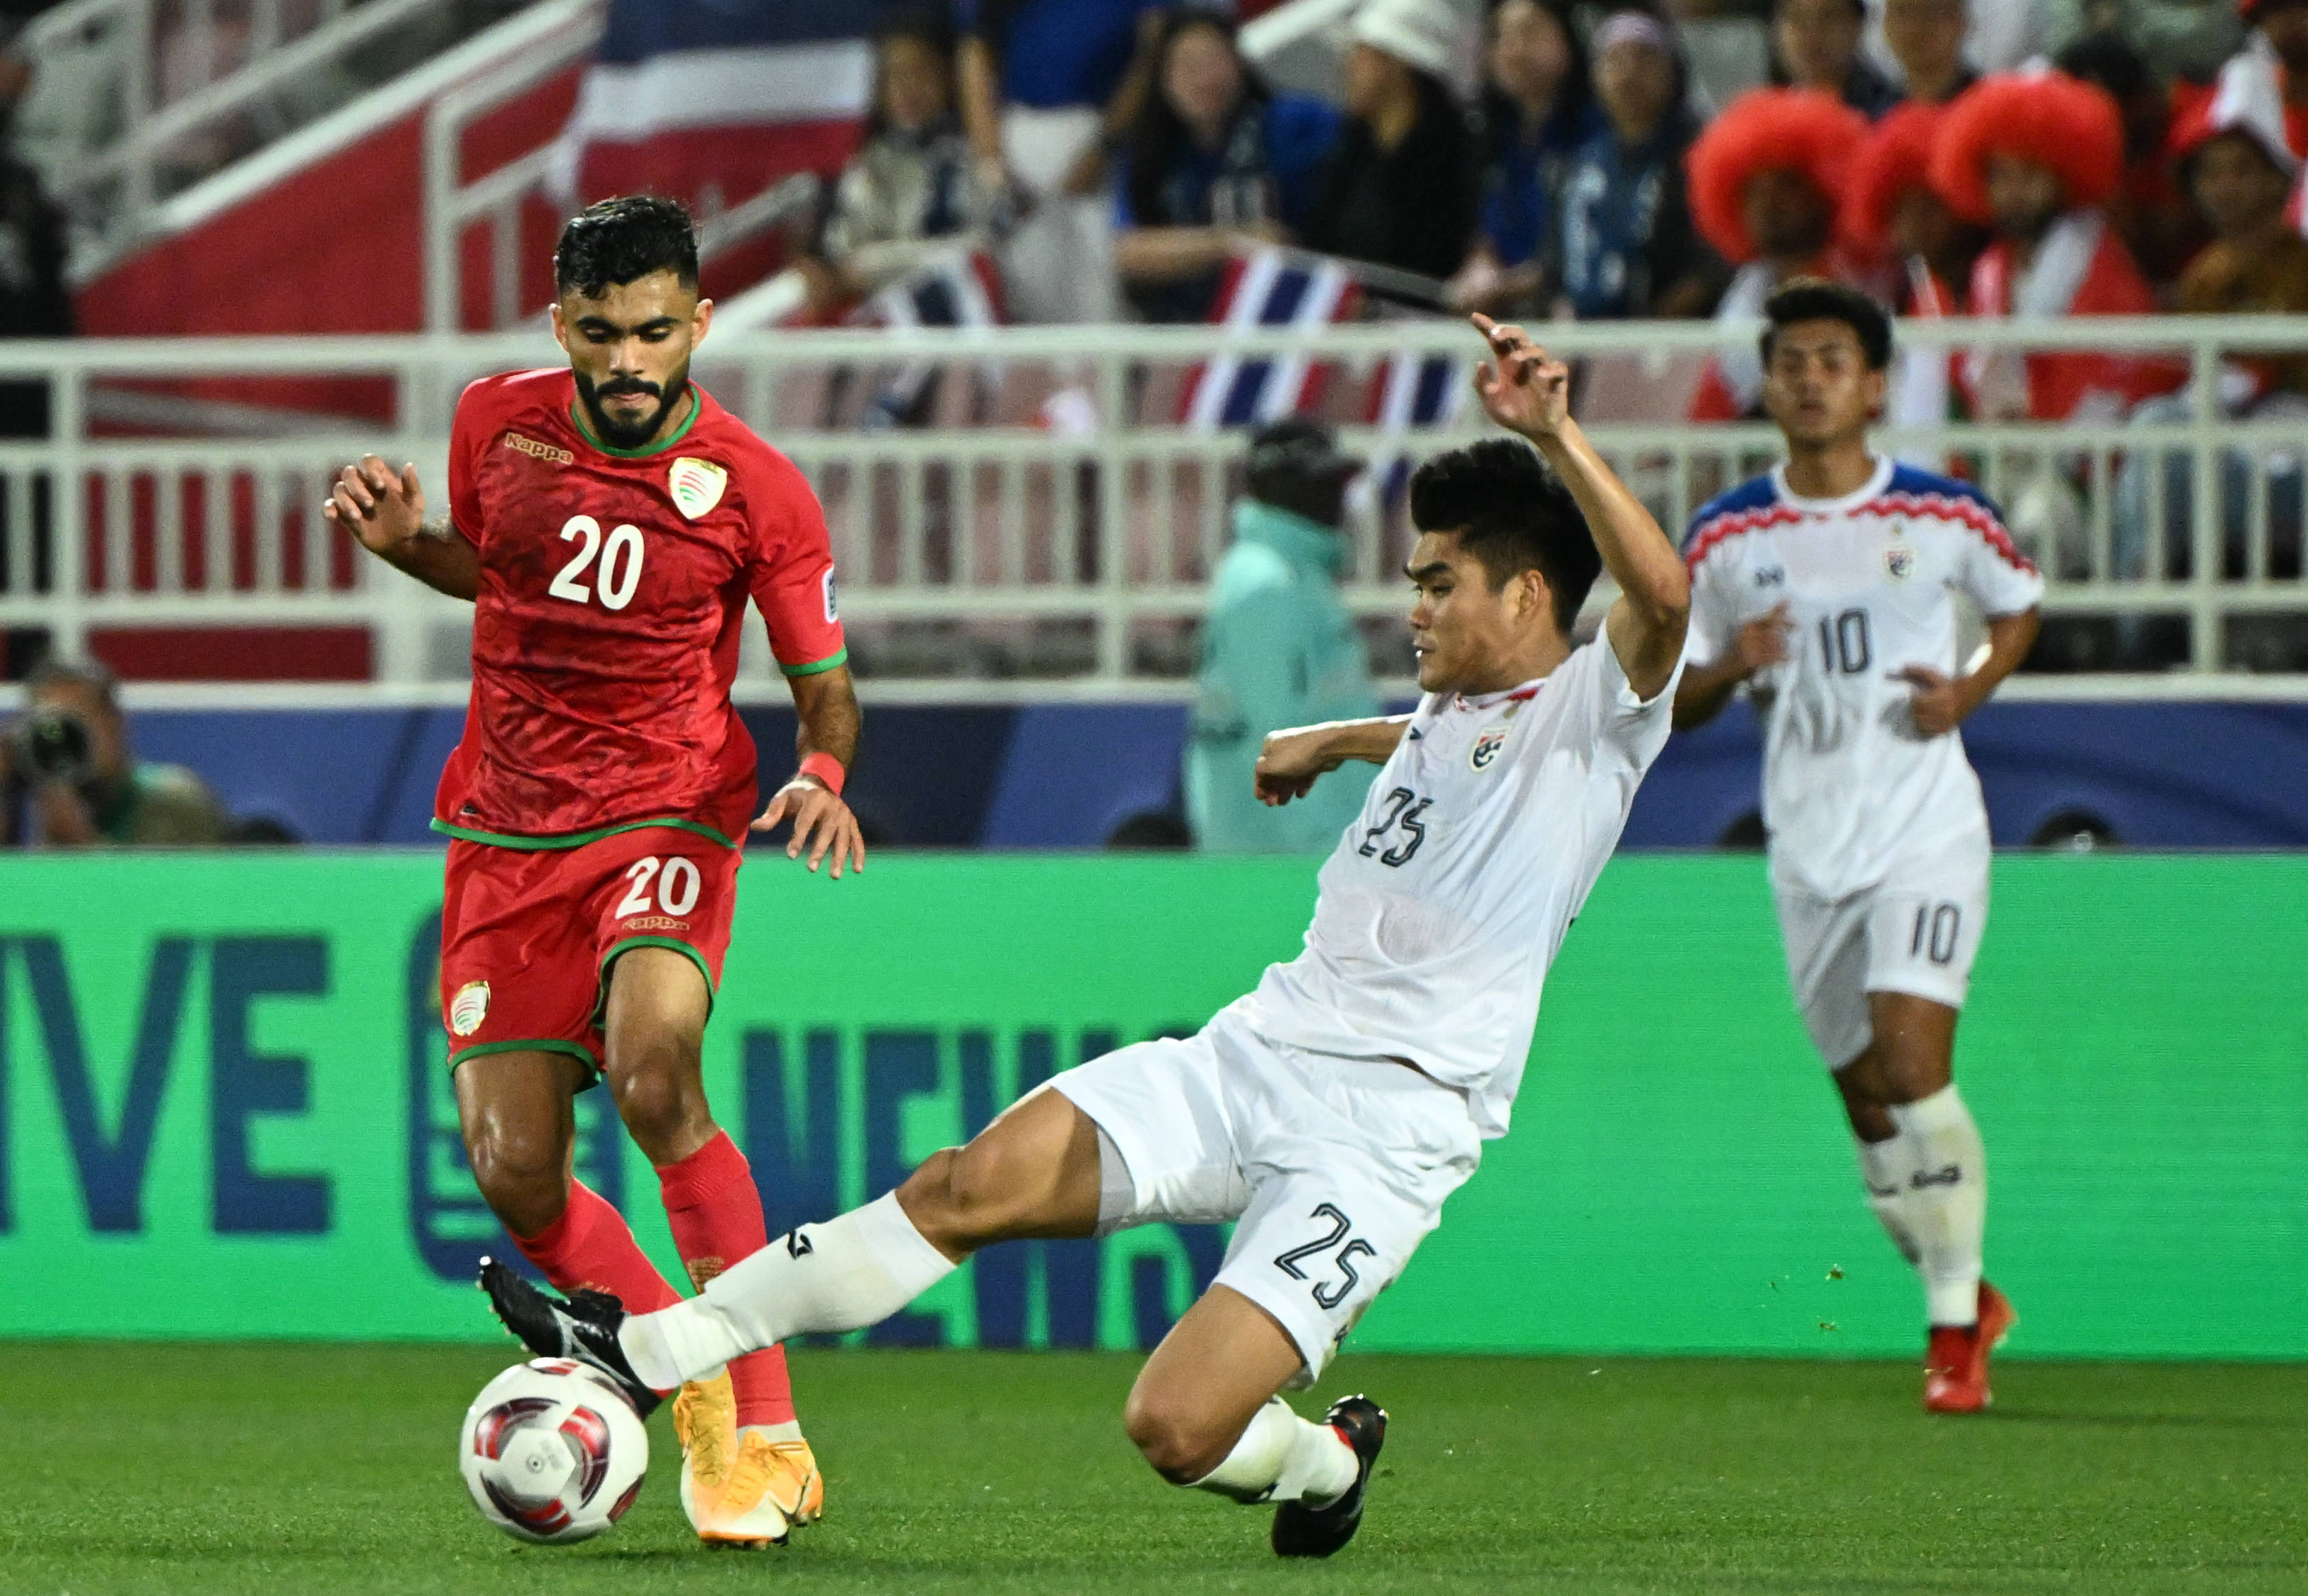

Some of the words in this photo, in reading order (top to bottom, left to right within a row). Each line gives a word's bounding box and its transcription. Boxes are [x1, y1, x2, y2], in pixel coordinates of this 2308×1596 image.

[504, 432, 573, 464] Kappa
[549, 515, 645, 610] 20
[1819, 609, 1870, 675] 10
[1359, 787, 1434, 867] 25
[614, 855, 701, 920] 20
[1910, 903, 1961, 965] 10
[0, 934, 331, 1231] VE
[742, 1028, 1230, 1348] NEW
[1273, 1202, 1378, 1310] 25
